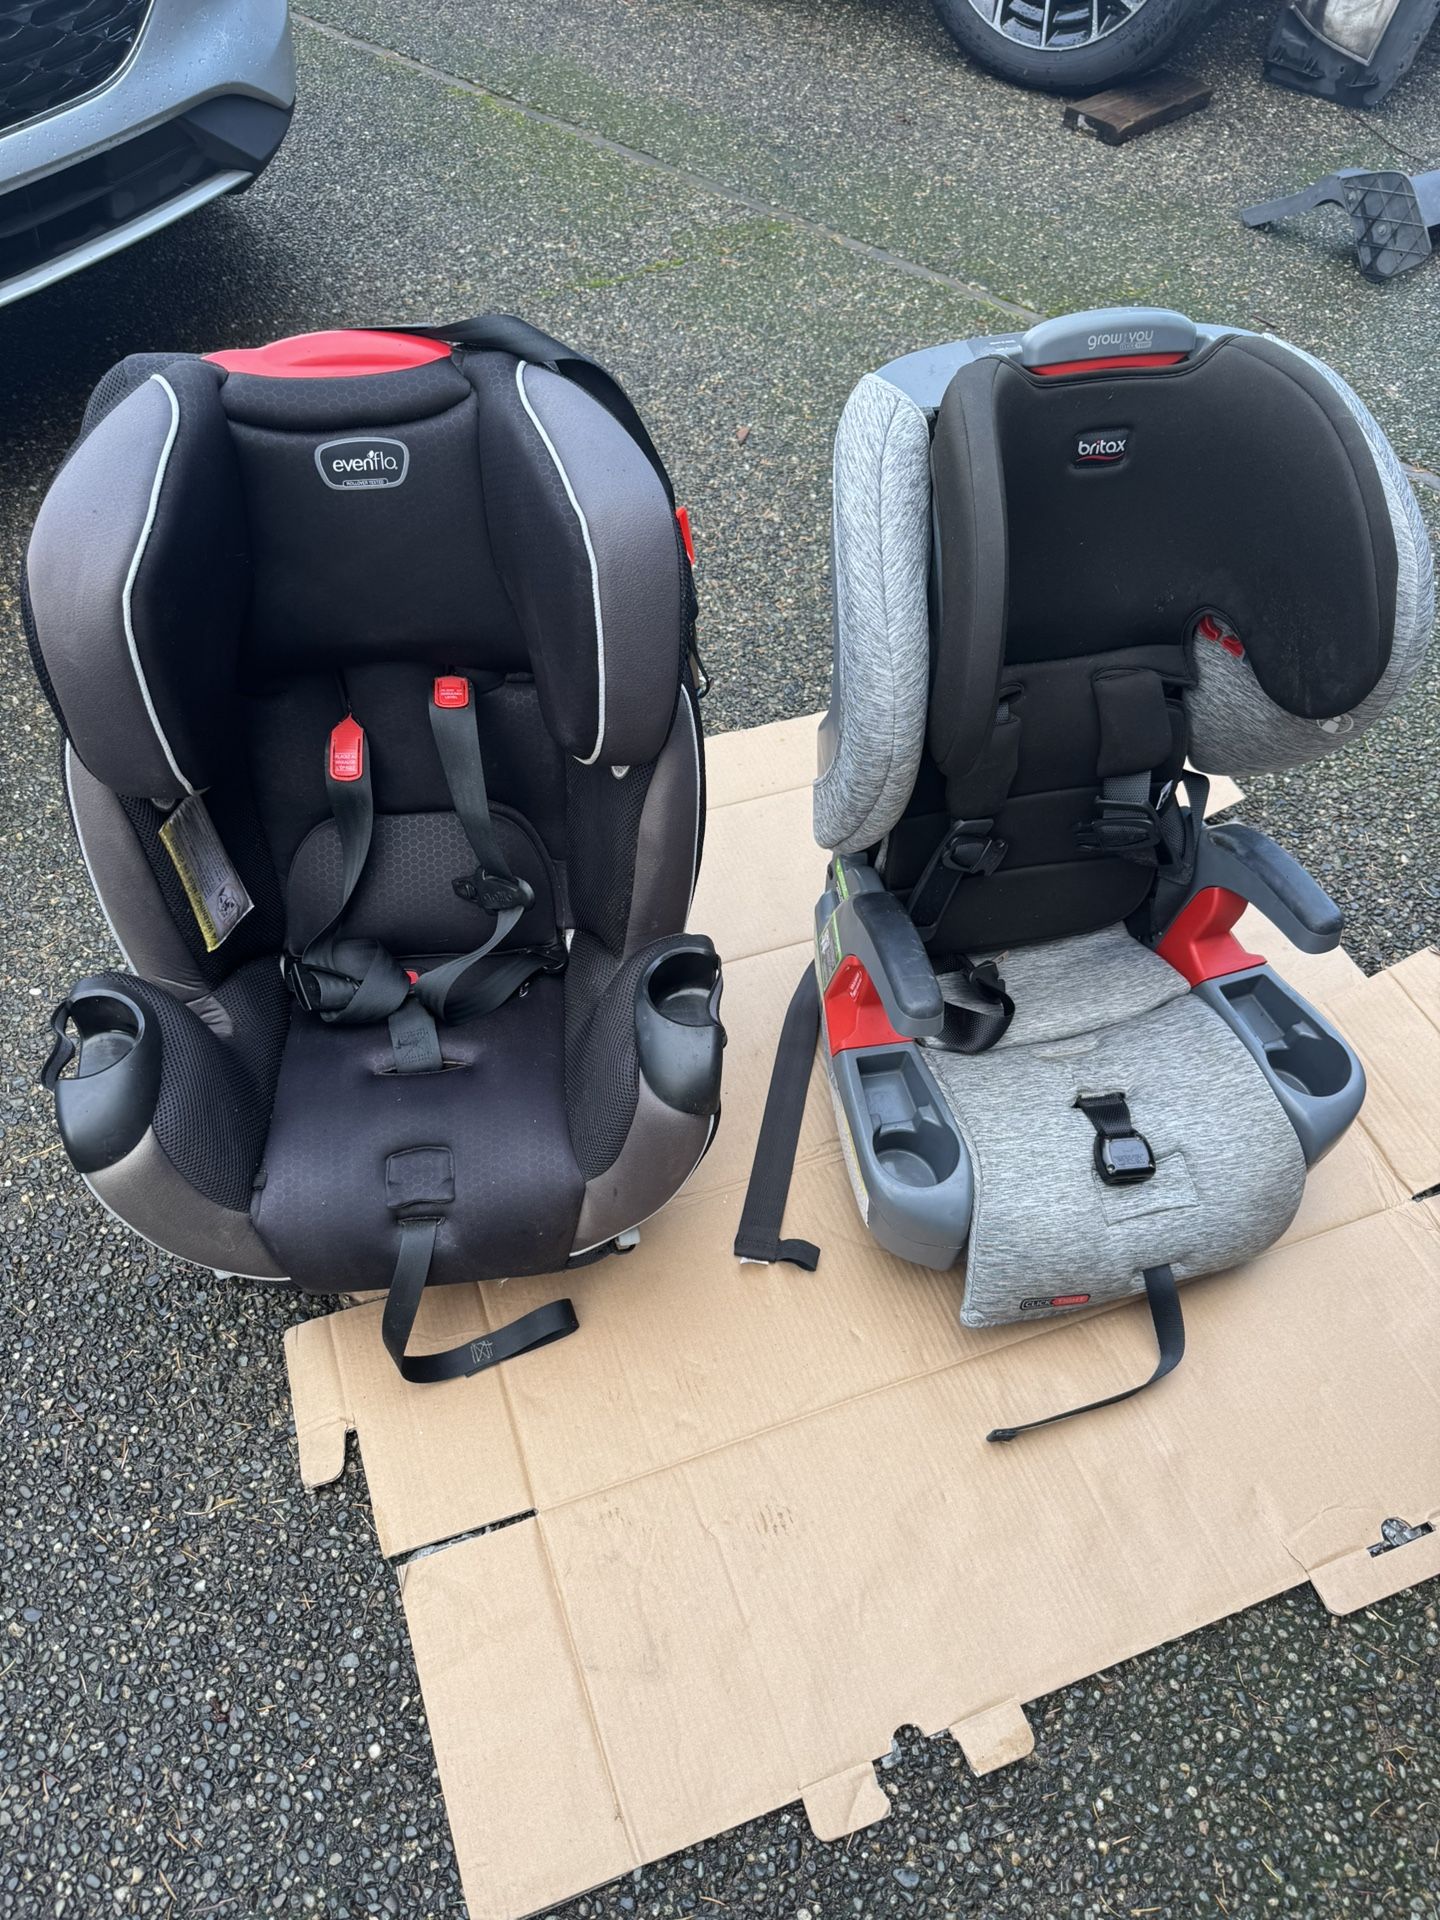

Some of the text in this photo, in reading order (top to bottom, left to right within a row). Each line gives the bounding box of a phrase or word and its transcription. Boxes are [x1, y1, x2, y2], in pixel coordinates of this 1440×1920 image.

[1087, 333, 1122, 350] grow
[1077, 439, 1126, 455] britax
[332, 450, 398, 472] evenflo
[1025, 1299, 1050, 1307] CLICK
